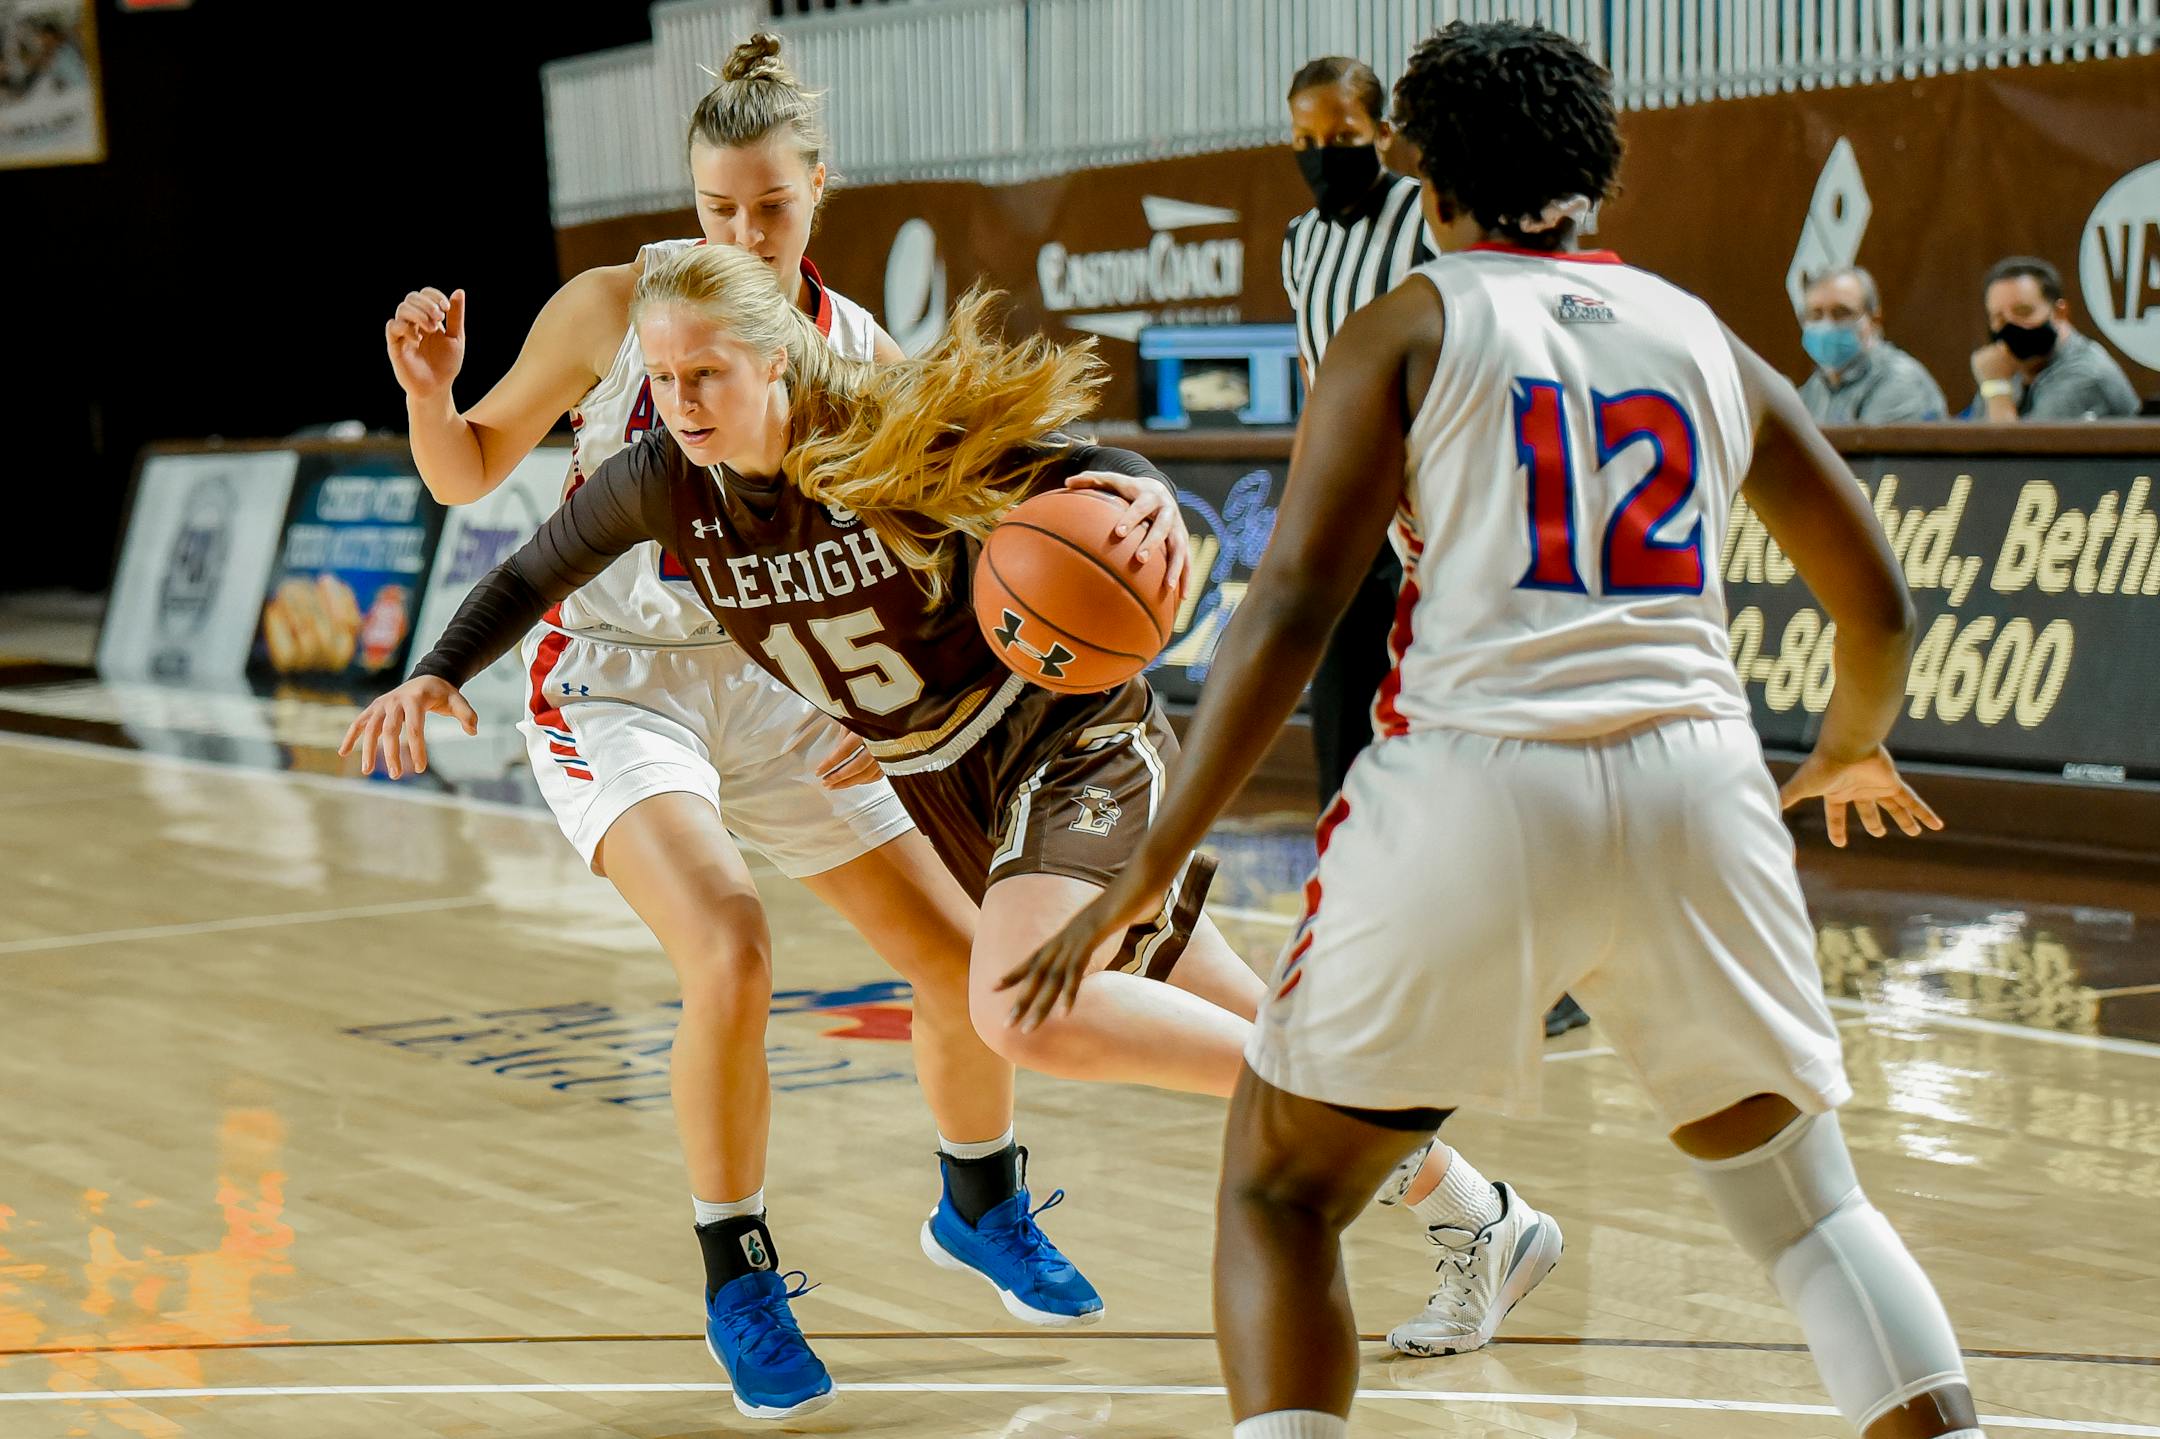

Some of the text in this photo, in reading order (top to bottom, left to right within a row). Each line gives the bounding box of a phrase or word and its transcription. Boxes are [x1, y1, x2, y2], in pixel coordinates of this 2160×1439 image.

[1510, 377, 1704, 595] 12
[695, 527, 898, 609] LEHIGH
[760, 607, 925, 719] 15
